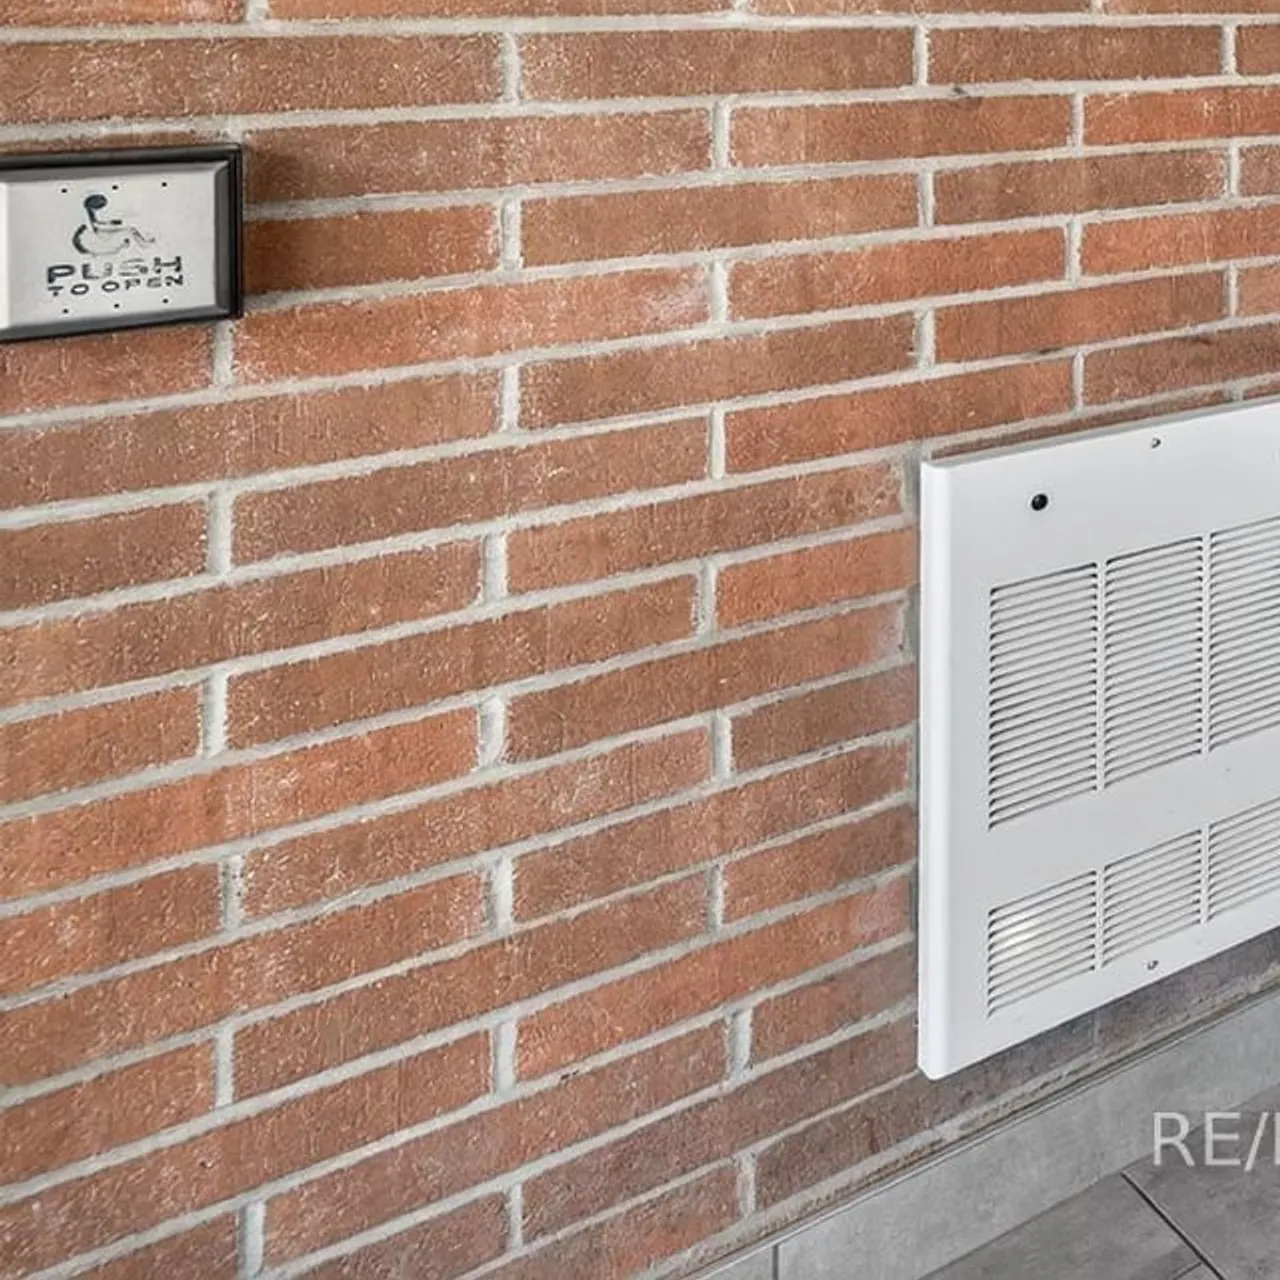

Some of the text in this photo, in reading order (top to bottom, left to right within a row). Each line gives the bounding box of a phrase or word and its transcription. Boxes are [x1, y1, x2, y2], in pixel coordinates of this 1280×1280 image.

[46, 256, 183, 284] PUSH
[47, 273, 184, 297] TO OPEN
